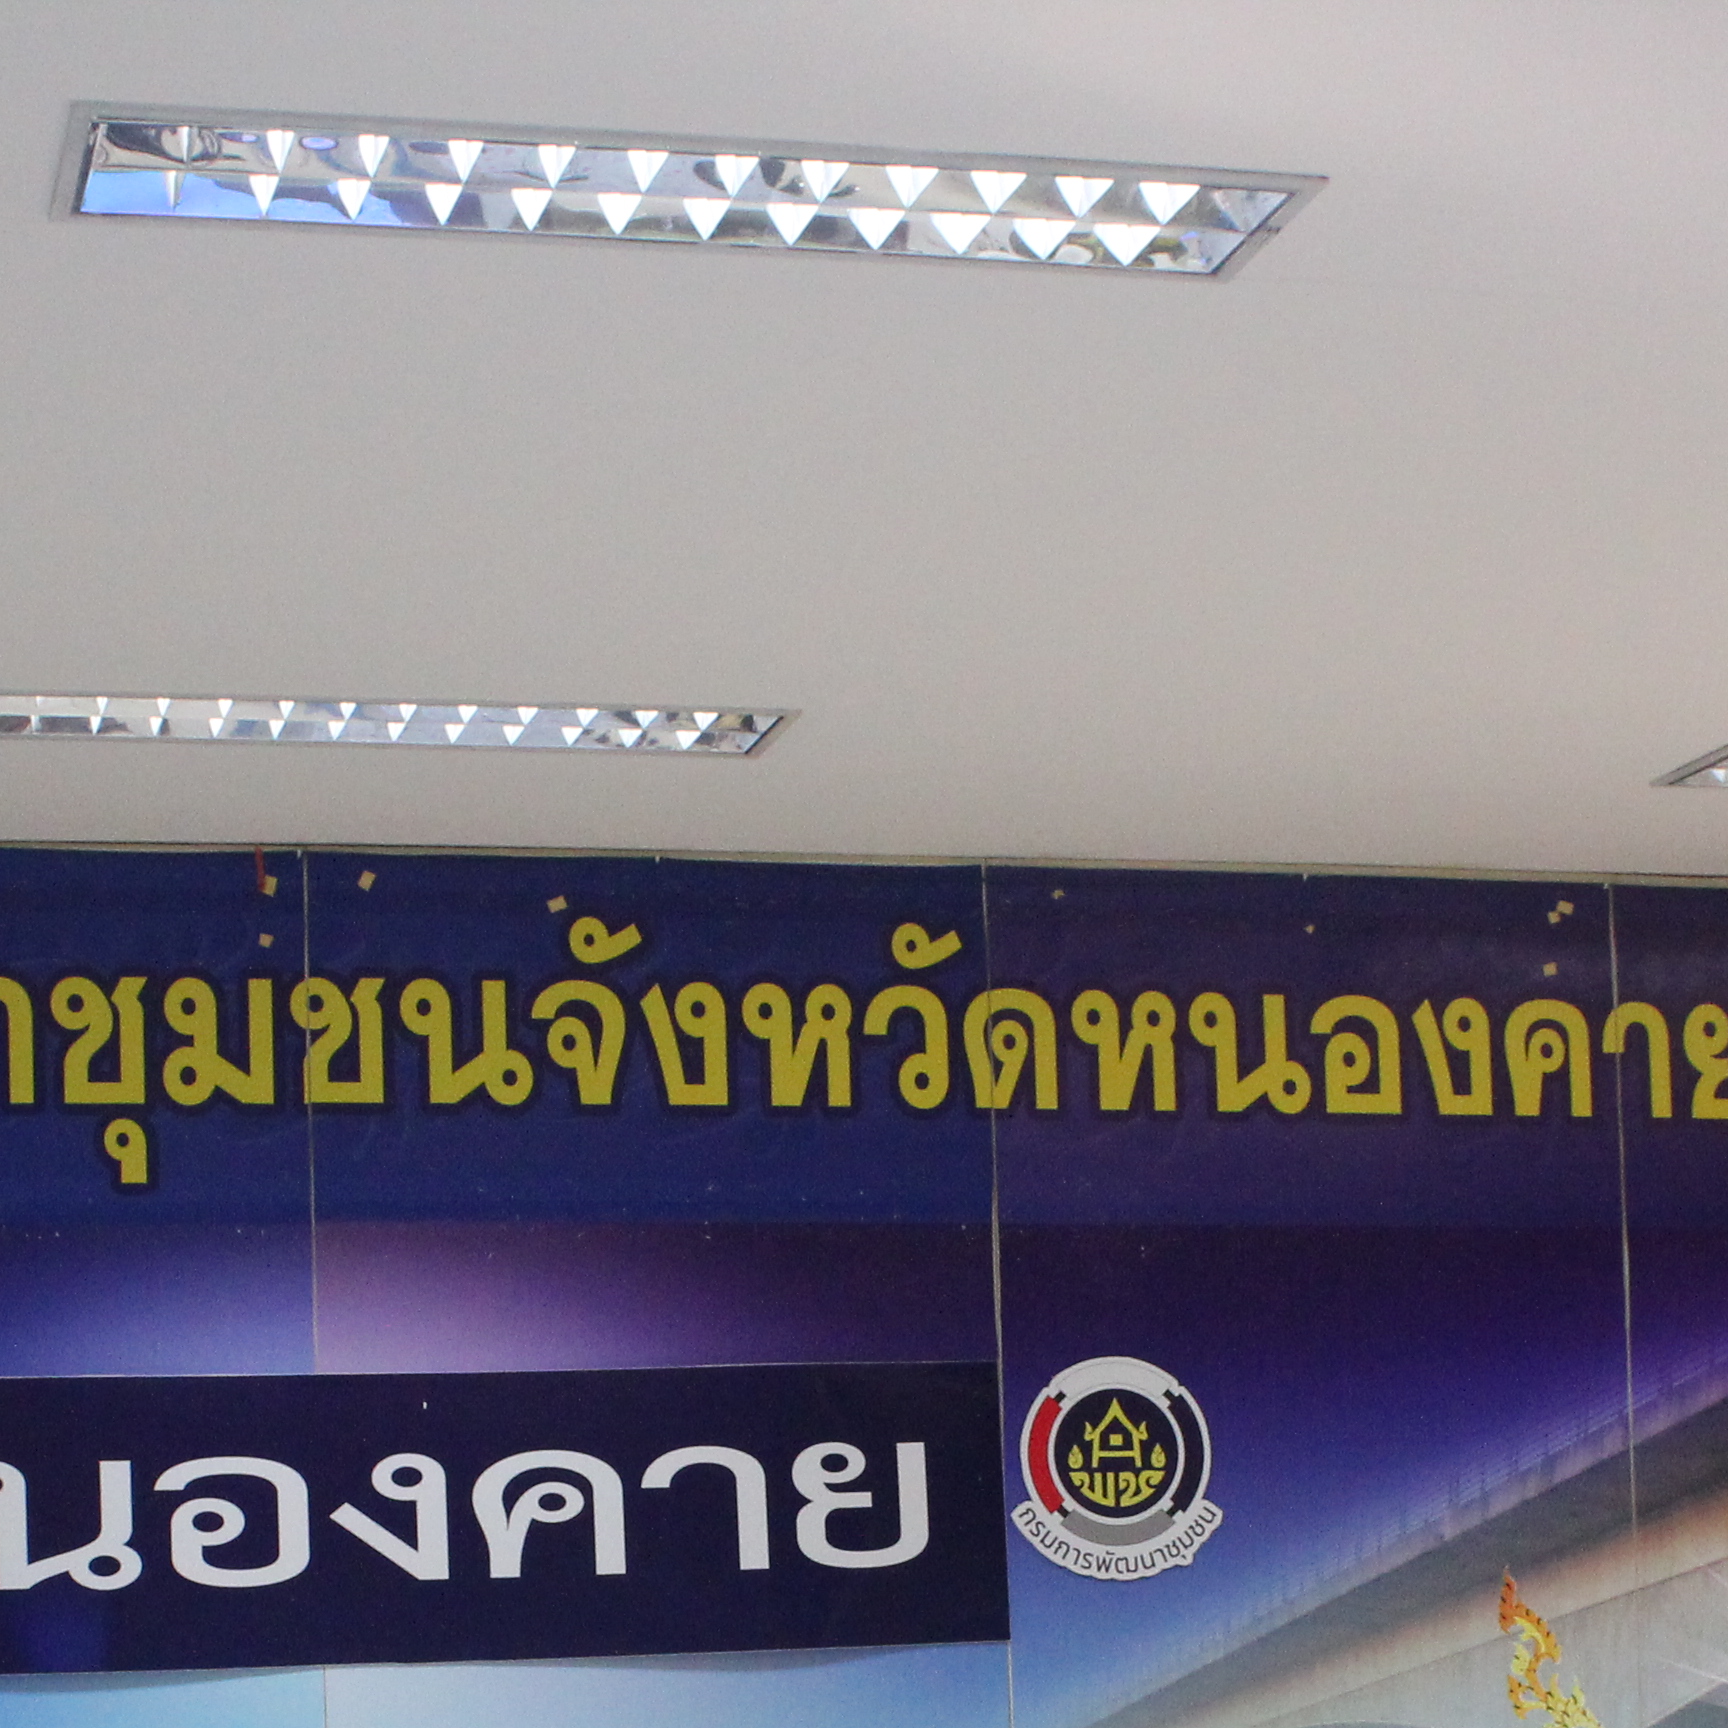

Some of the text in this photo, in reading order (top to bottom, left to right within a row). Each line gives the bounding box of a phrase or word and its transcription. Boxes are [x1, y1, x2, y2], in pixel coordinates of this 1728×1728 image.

[1019, 1507, 1217, 1574] กรมการพัฒนาชุมชน
